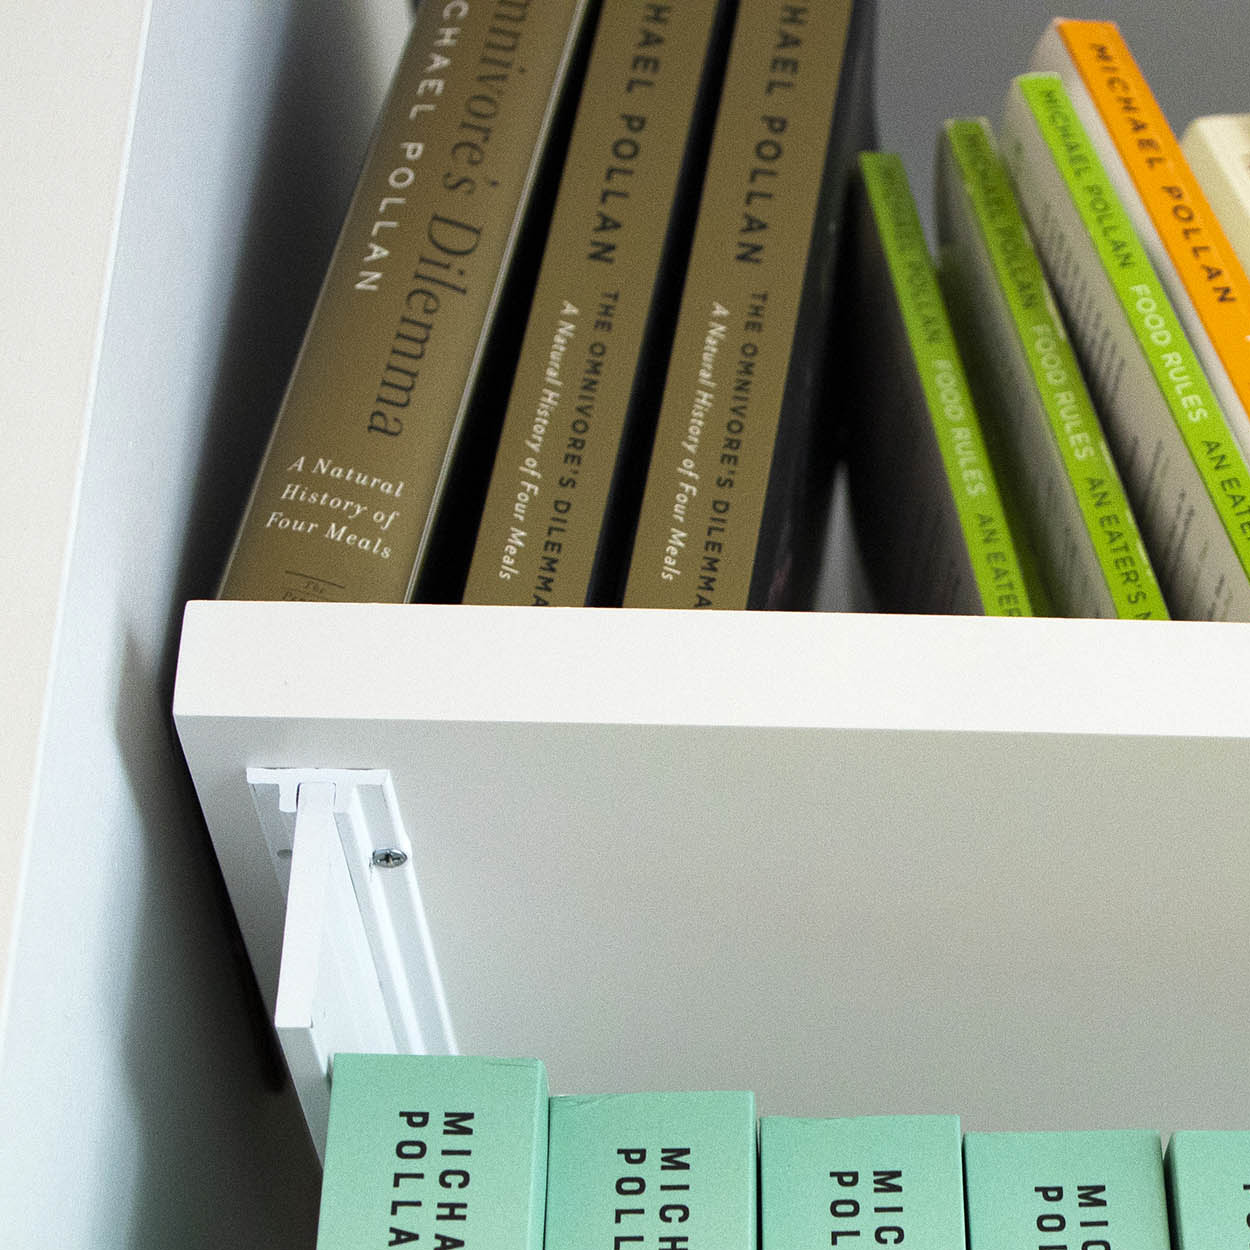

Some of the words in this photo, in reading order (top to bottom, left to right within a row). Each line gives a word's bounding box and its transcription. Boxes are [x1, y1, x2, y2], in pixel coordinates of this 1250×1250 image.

[409, 0, 469, 119] CHAEL
[626, 3, 670, 94] HAEL
[764, 3, 808, 96] HAEL
[443, 0, 532, 195] mnivore's
[587, 113, 647, 264] POLLAN
[735, 114, 788, 264] POLLAN
[1040, 90, 1090, 177] MICHAEL
[1084, 183, 1135, 268] POLLAN
[1089, 43, 1166, 168] MICHAEL
[1162, 186, 1236, 304] POLLAN
[355, 142, 424, 291] POLLAN
[368, 214, 482, 437] Dilemma
[563, 301, 579, 317] A
[594, 291, 619, 333] THE
[711, 302, 730, 317] A
[743, 291, 767, 333] THE
[545, 320, 576, 388] Natural
[698, 321, 727, 389] Natural
[1130, 284, 1172, 347] FOOD
[1161, 351, 1208, 423] RULES
[524, 388, 560, 452] History
[559, 342, 606, 490] OMNIVORE'S
[682, 389, 714, 454] History
[716, 342, 758, 490] OMNIVORE'S
[1031, 321, 1068, 389] FOOD
[1054, 392, 1095, 463] RULES
[932, 359, 963, 422] FOOD
[951, 426, 986, 497] RULES
[1202, 439, 1230, 471] AN
[287, 456, 305, 472] A
[312, 458, 404, 497] Natural
[513, 480, 538, 523] Four
[518, 457, 542, 479] of
[678, 457, 699, 481] of
[266, 511, 318, 533] Four
[325, 522, 391, 559] Meals
[281, 483, 368, 519] History
[372, 510, 399, 531] of
[673, 481, 697, 524] Four
[977, 512, 1002, 545] AN
[499, 527, 527, 581] Meals
[661, 528, 688, 582] Meals
[694, 499, 730, 608] DILEMMA
[1086, 475, 1112, 509] AN
[1100, 513, 1148, 604] EATER'S
